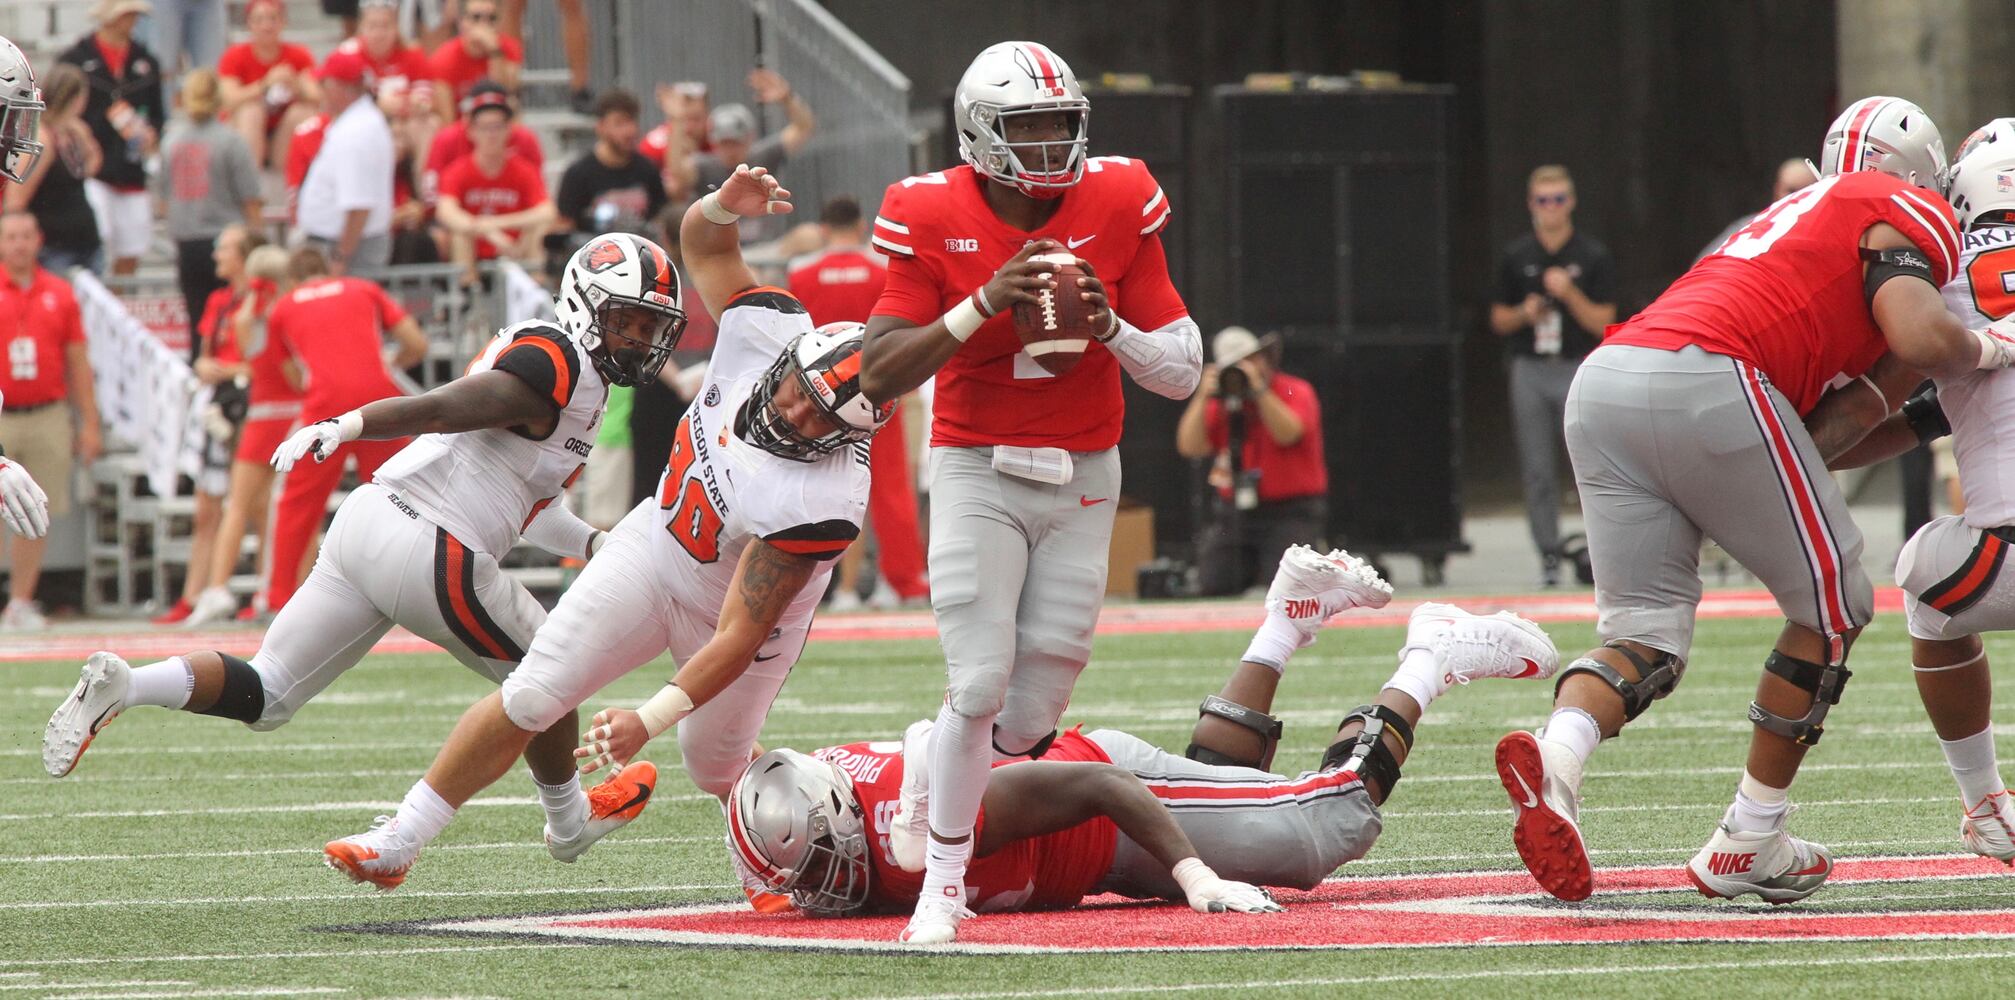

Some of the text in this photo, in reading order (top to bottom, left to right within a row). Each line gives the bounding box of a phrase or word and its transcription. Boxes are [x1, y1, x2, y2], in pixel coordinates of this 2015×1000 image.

[652, 293, 671, 306] OSU
[812, 376, 831, 397] OSU
[703, 454, 730, 518] STATE
[387, 492, 420, 520] BEAVERS
[1285, 598, 1320, 619] NIKE
[1707, 851, 1757, 876] NIKE
